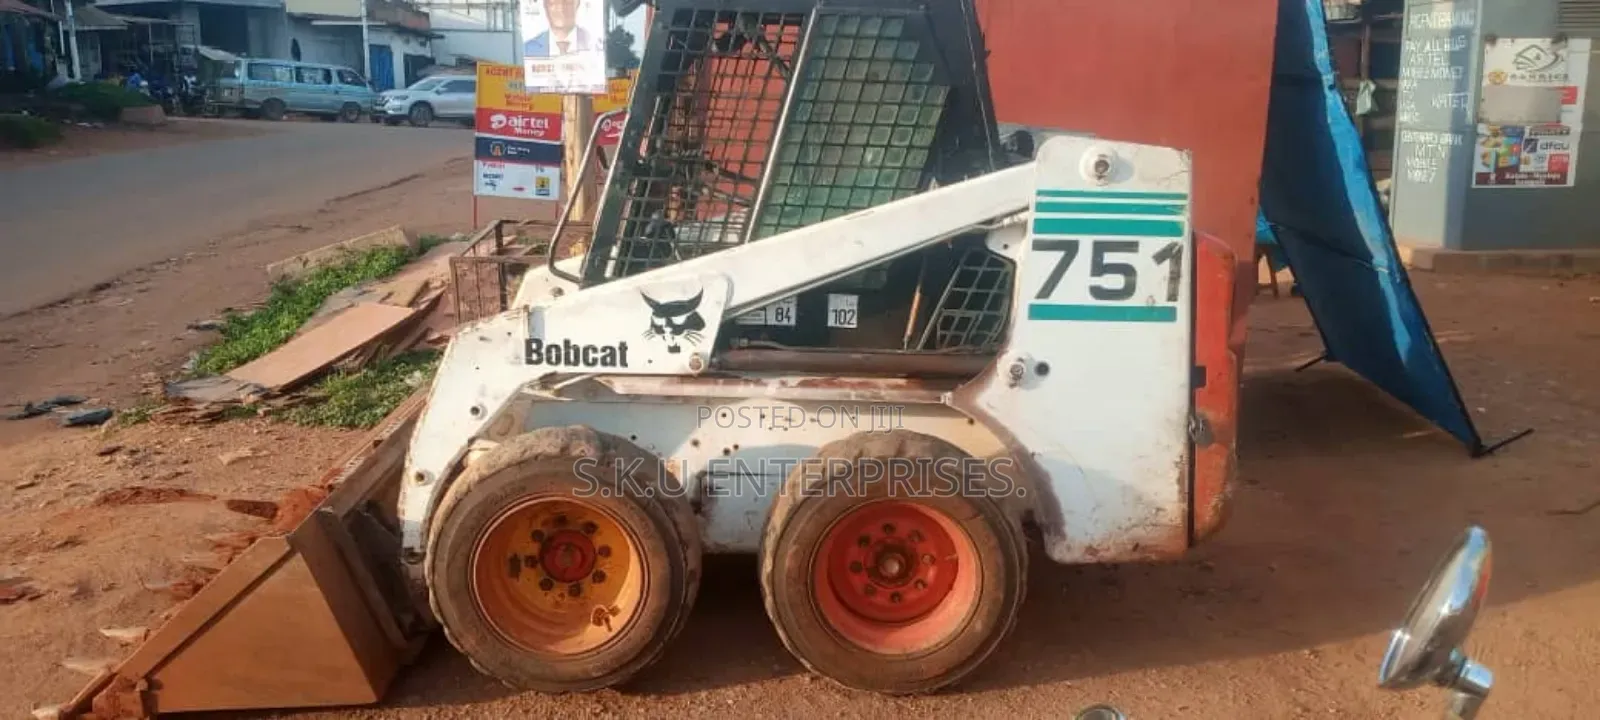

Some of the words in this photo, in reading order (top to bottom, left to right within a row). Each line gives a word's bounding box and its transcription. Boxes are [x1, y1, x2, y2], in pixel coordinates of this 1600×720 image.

[508, 115, 549, 130] airtel
[1032, 239, 1184, 302] 751
[775, 307, 792, 323] 84
[831, 308, 856, 326] 102
[524, 338, 628, 368] Bobcat
